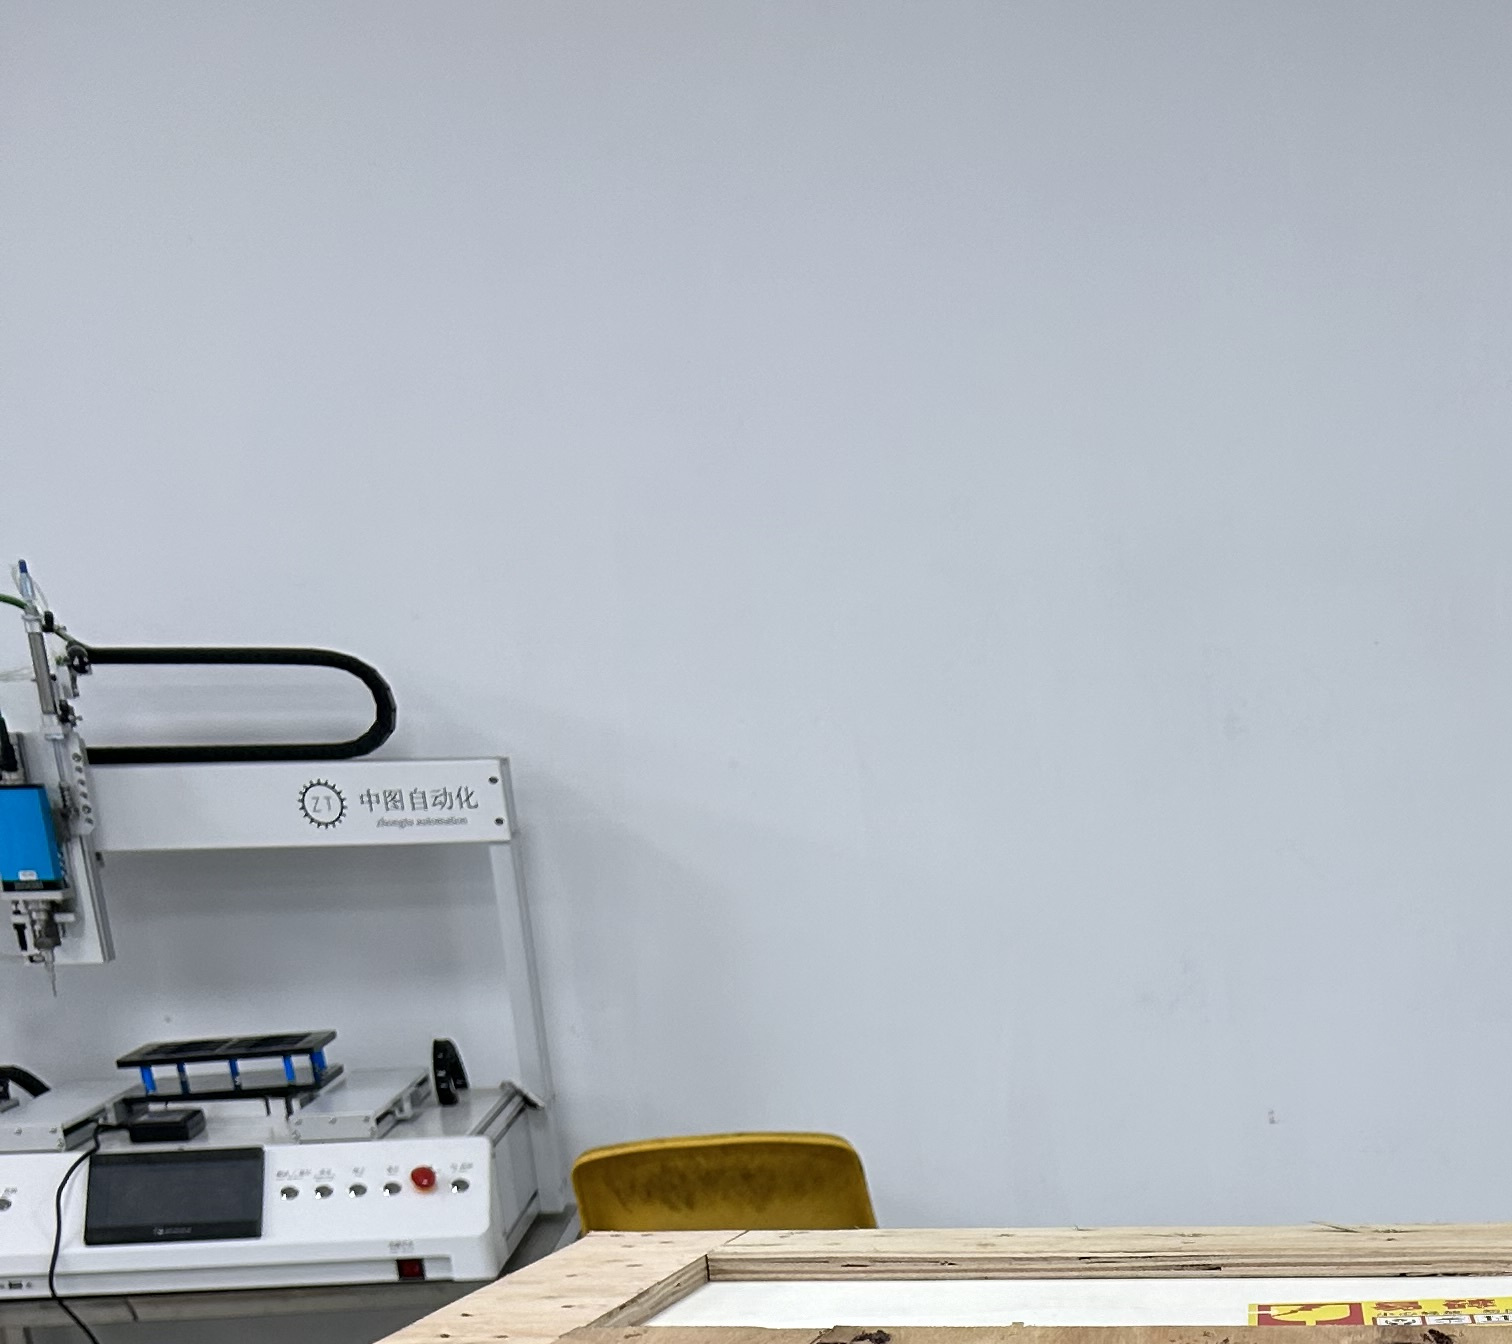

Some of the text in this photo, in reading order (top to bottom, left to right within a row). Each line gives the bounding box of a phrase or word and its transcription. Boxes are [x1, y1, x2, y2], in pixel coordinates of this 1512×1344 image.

[359, 785, 479, 812] 中图自动化
